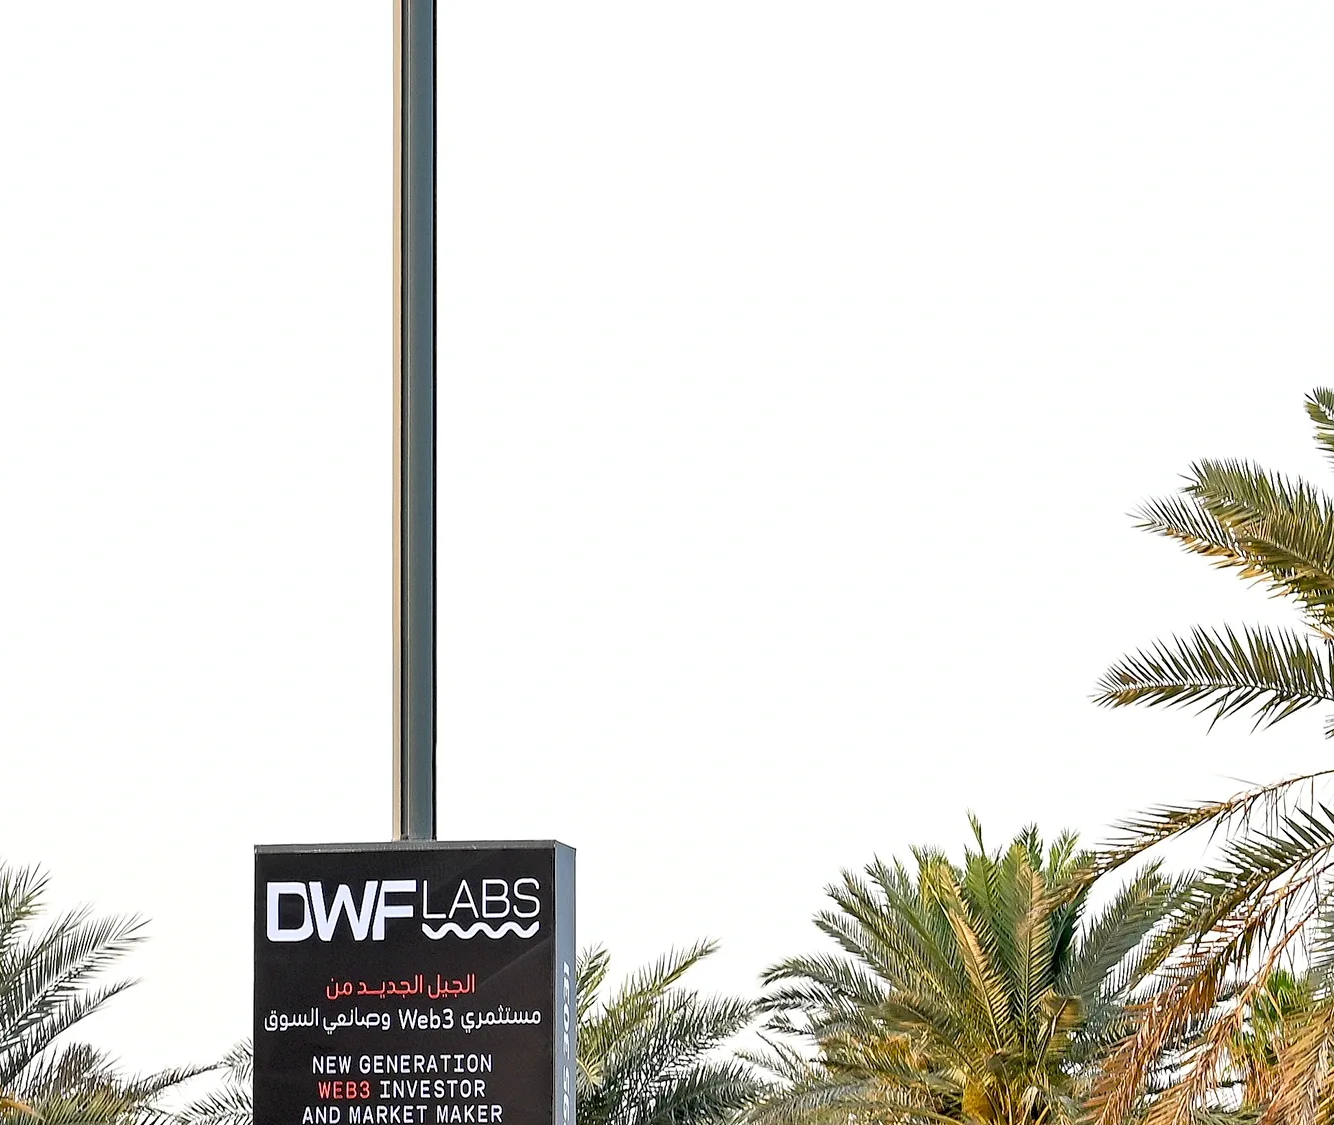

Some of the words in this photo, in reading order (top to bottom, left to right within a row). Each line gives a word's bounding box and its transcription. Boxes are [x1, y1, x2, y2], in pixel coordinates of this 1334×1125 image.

[266, 879, 417, 942] DWF
[422, 877, 542, 920] LABS
[326, 976, 354, 1000] من
[427, 973, 476, 999] الجيل
[264, 1007, 319, 1032] السوق
[322, 1007, 391, 1035] وصانعي
[398, 1008, 455, 1030] Web3
[460, 1004, 542, 1034] مستثمري
[562, 961, 571, 1061] 3031
[312, 1055, 352, 1075] NEW
[359, 1053, 493, 1074] GENERATION
[318, 1080, 371, 1100] WEB3
[379, 1079, 486, 1099] INVESTOR
[302, 1106, 342, 1125] AND
[349, 1105, 428, 1125] MARKET
[436, 1104, 503, 1123] MAKER
